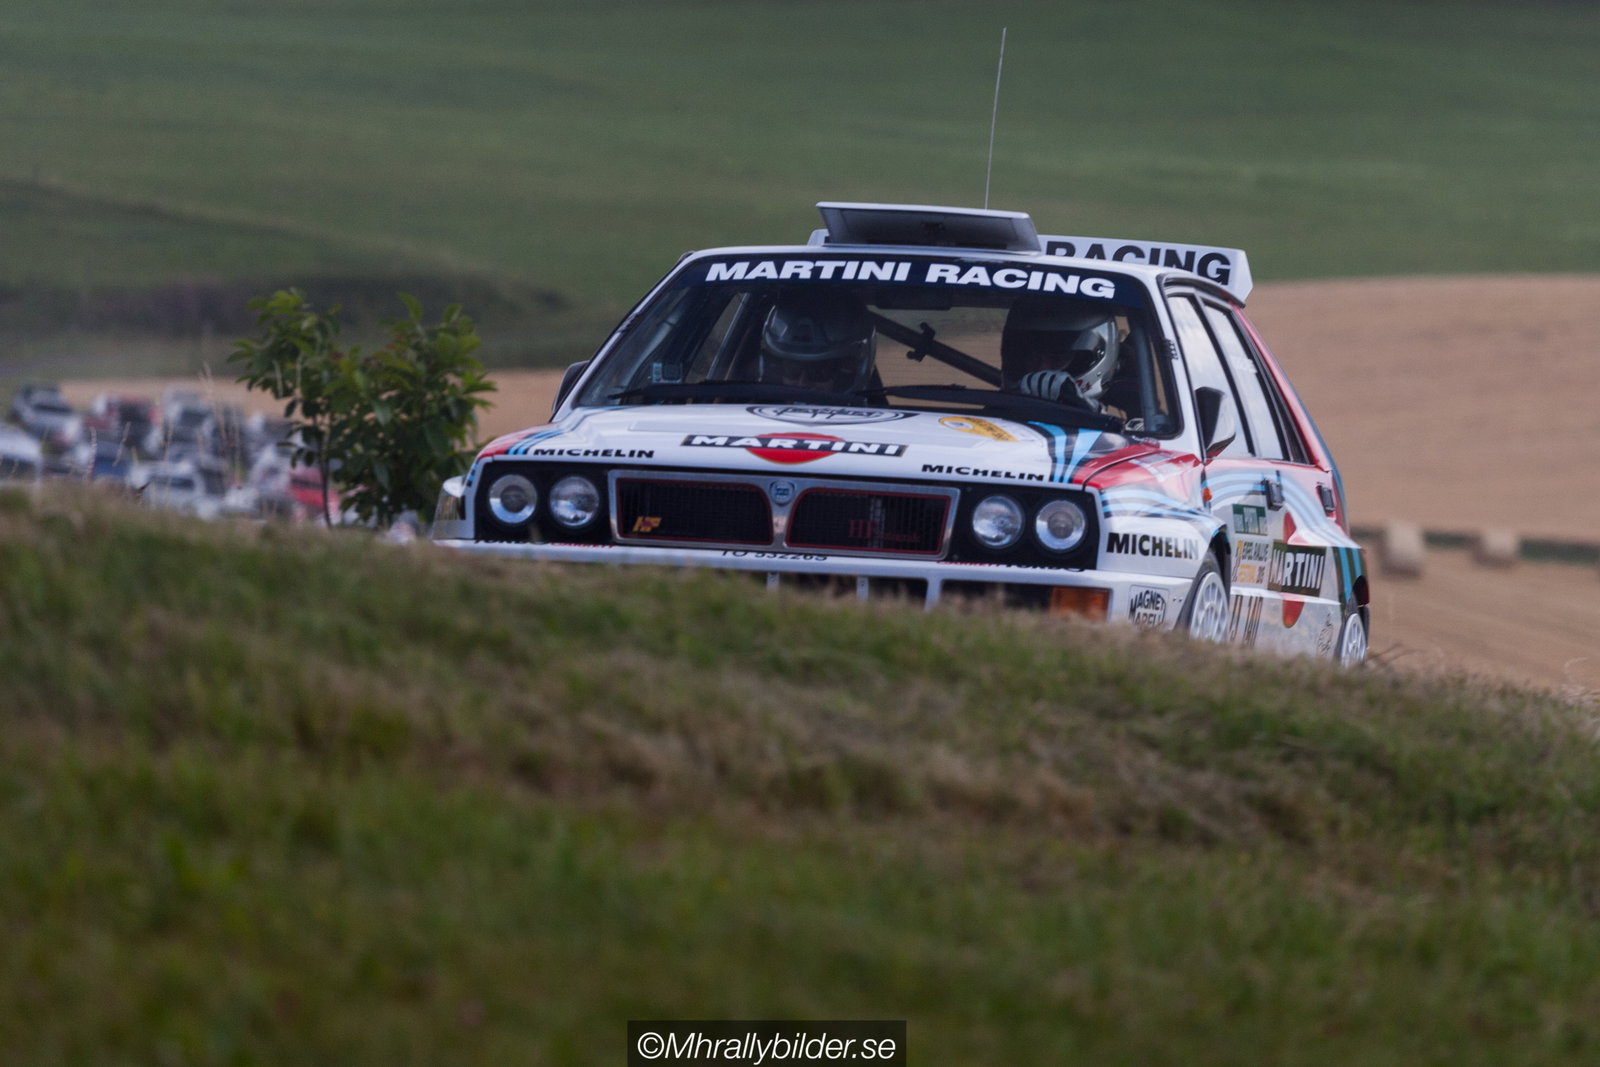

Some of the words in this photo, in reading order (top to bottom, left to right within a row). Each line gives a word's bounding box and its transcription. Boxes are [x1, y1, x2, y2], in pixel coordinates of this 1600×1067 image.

[705, 261, 911, 282] MARTINI
[926, 263, 1115, 299] RACING
[533, 448, 655, 459] MICHELIN
[691, 435, 900, 455] MARTINI
[921, 463, 1045, 482] MICHELIN
[1106, 532, 1199, 561] MICHELIN
[1269, 549, 1325, 590] MARTINI
